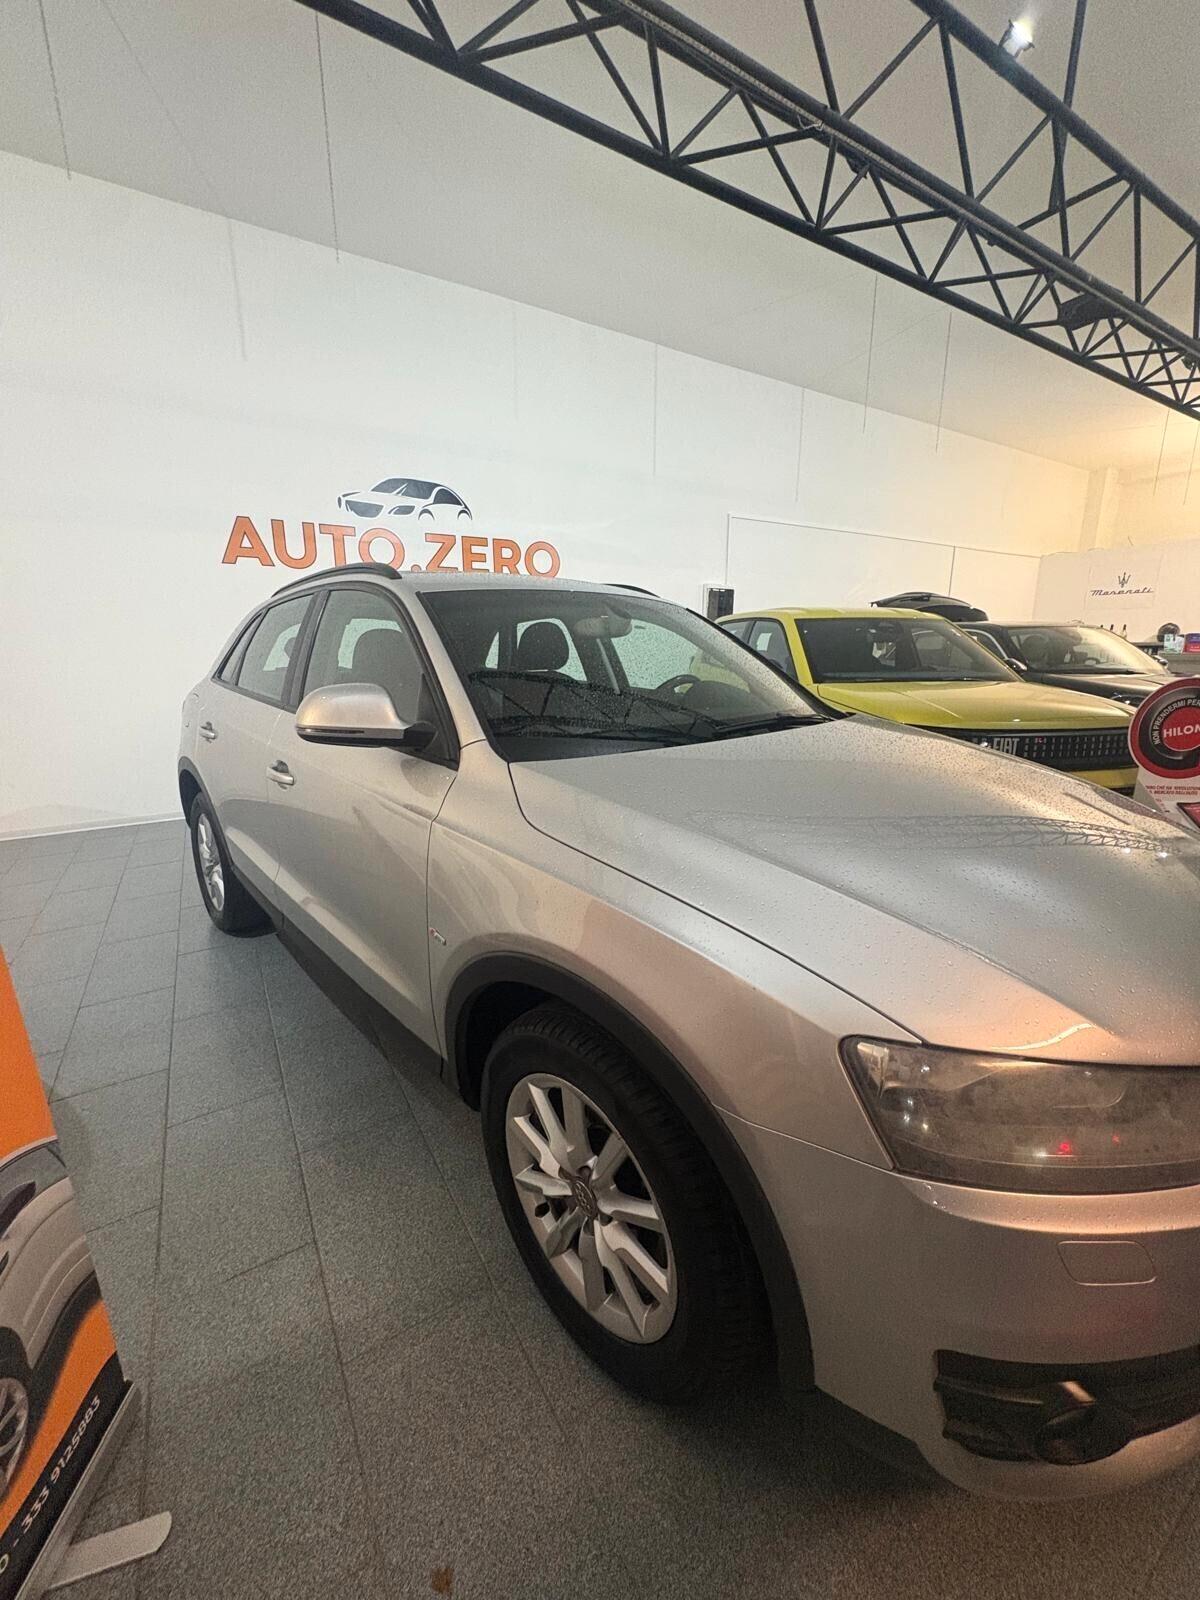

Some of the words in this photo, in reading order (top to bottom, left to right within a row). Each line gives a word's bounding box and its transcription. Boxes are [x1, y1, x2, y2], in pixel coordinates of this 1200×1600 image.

[1090, 587, 1154, 596] Maserati
[1153, 700, 1186, 730] PRENDERMI
[993, 737, 1020, 755] FIAT
[1152, 732, 1161, 745] NON
[21, 1485, 49, 1535] 333
